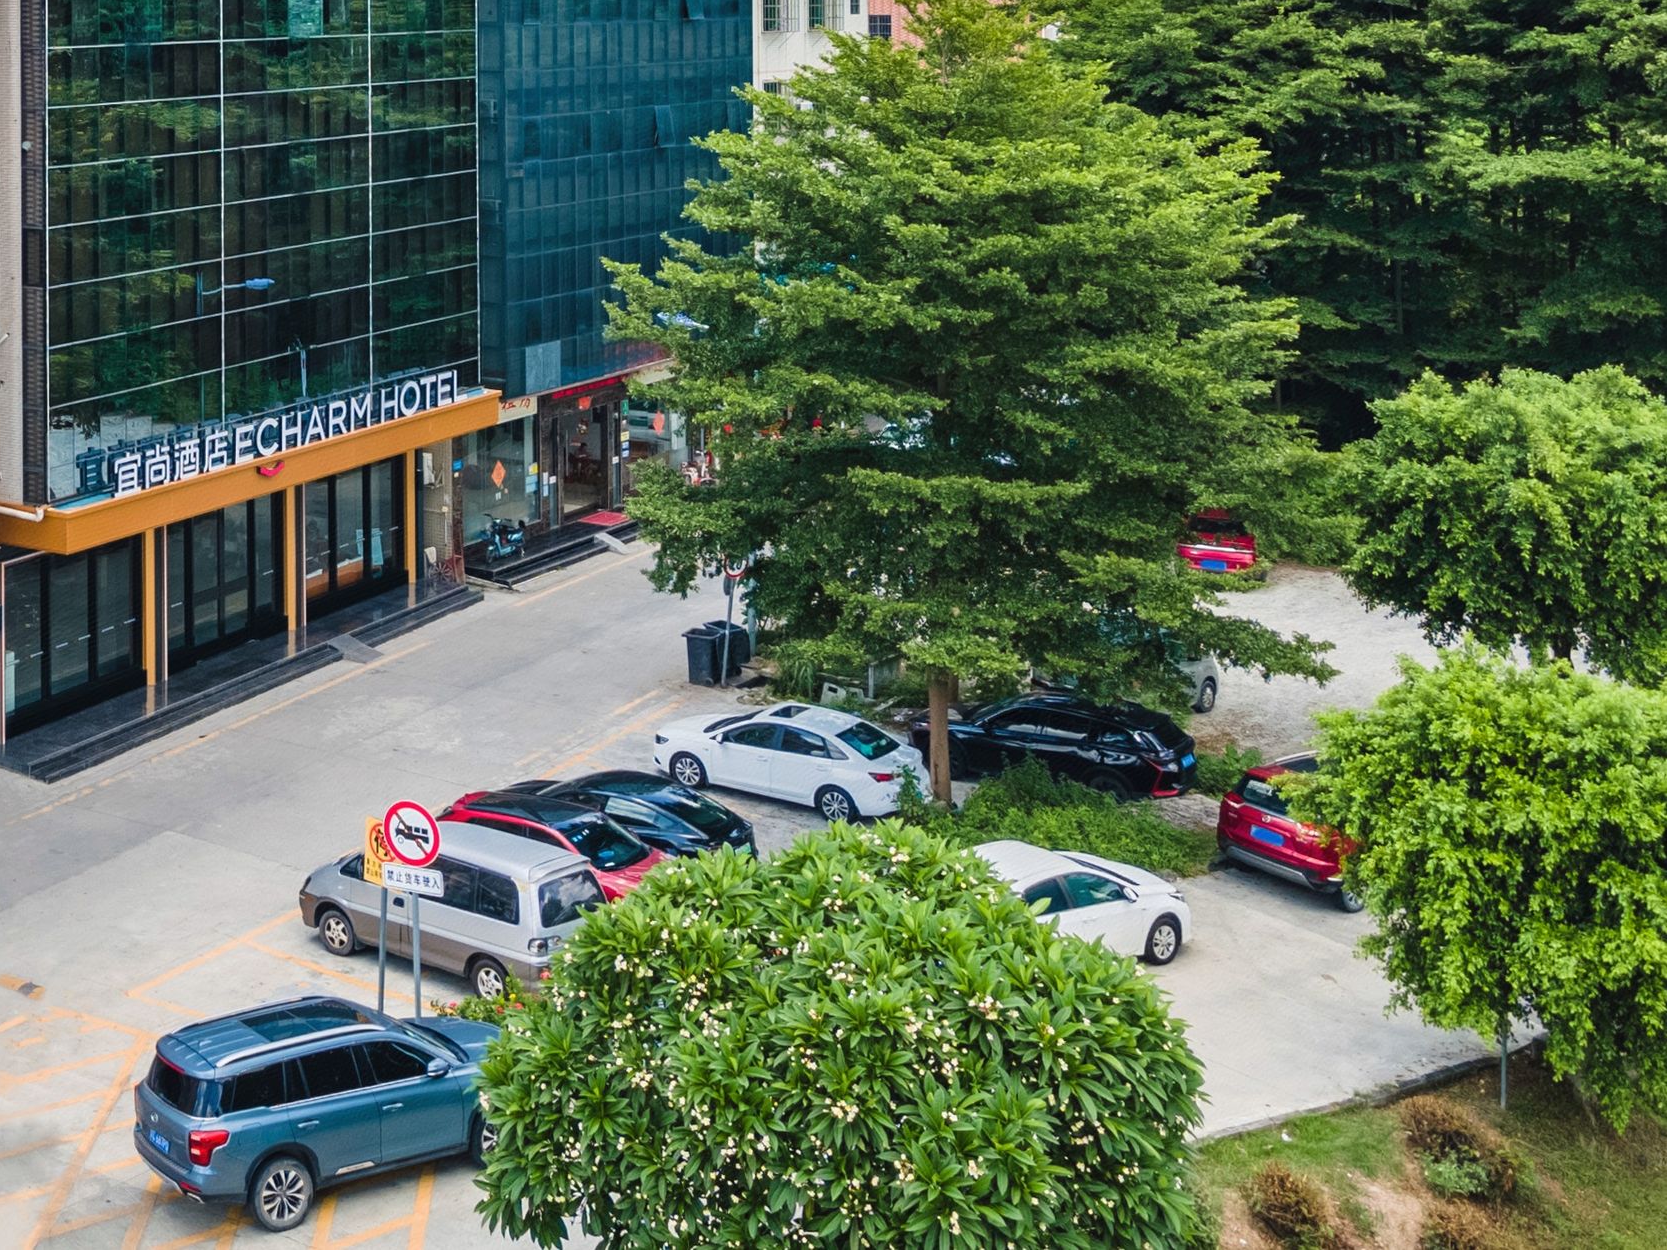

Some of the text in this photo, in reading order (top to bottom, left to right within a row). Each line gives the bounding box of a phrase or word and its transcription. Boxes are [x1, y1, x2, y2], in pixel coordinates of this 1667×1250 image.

[114, 370, 469, 498] 宜尚酒店 ECHARM HOTEL
[387, 869, 440, 890] 禁止货车驶入
